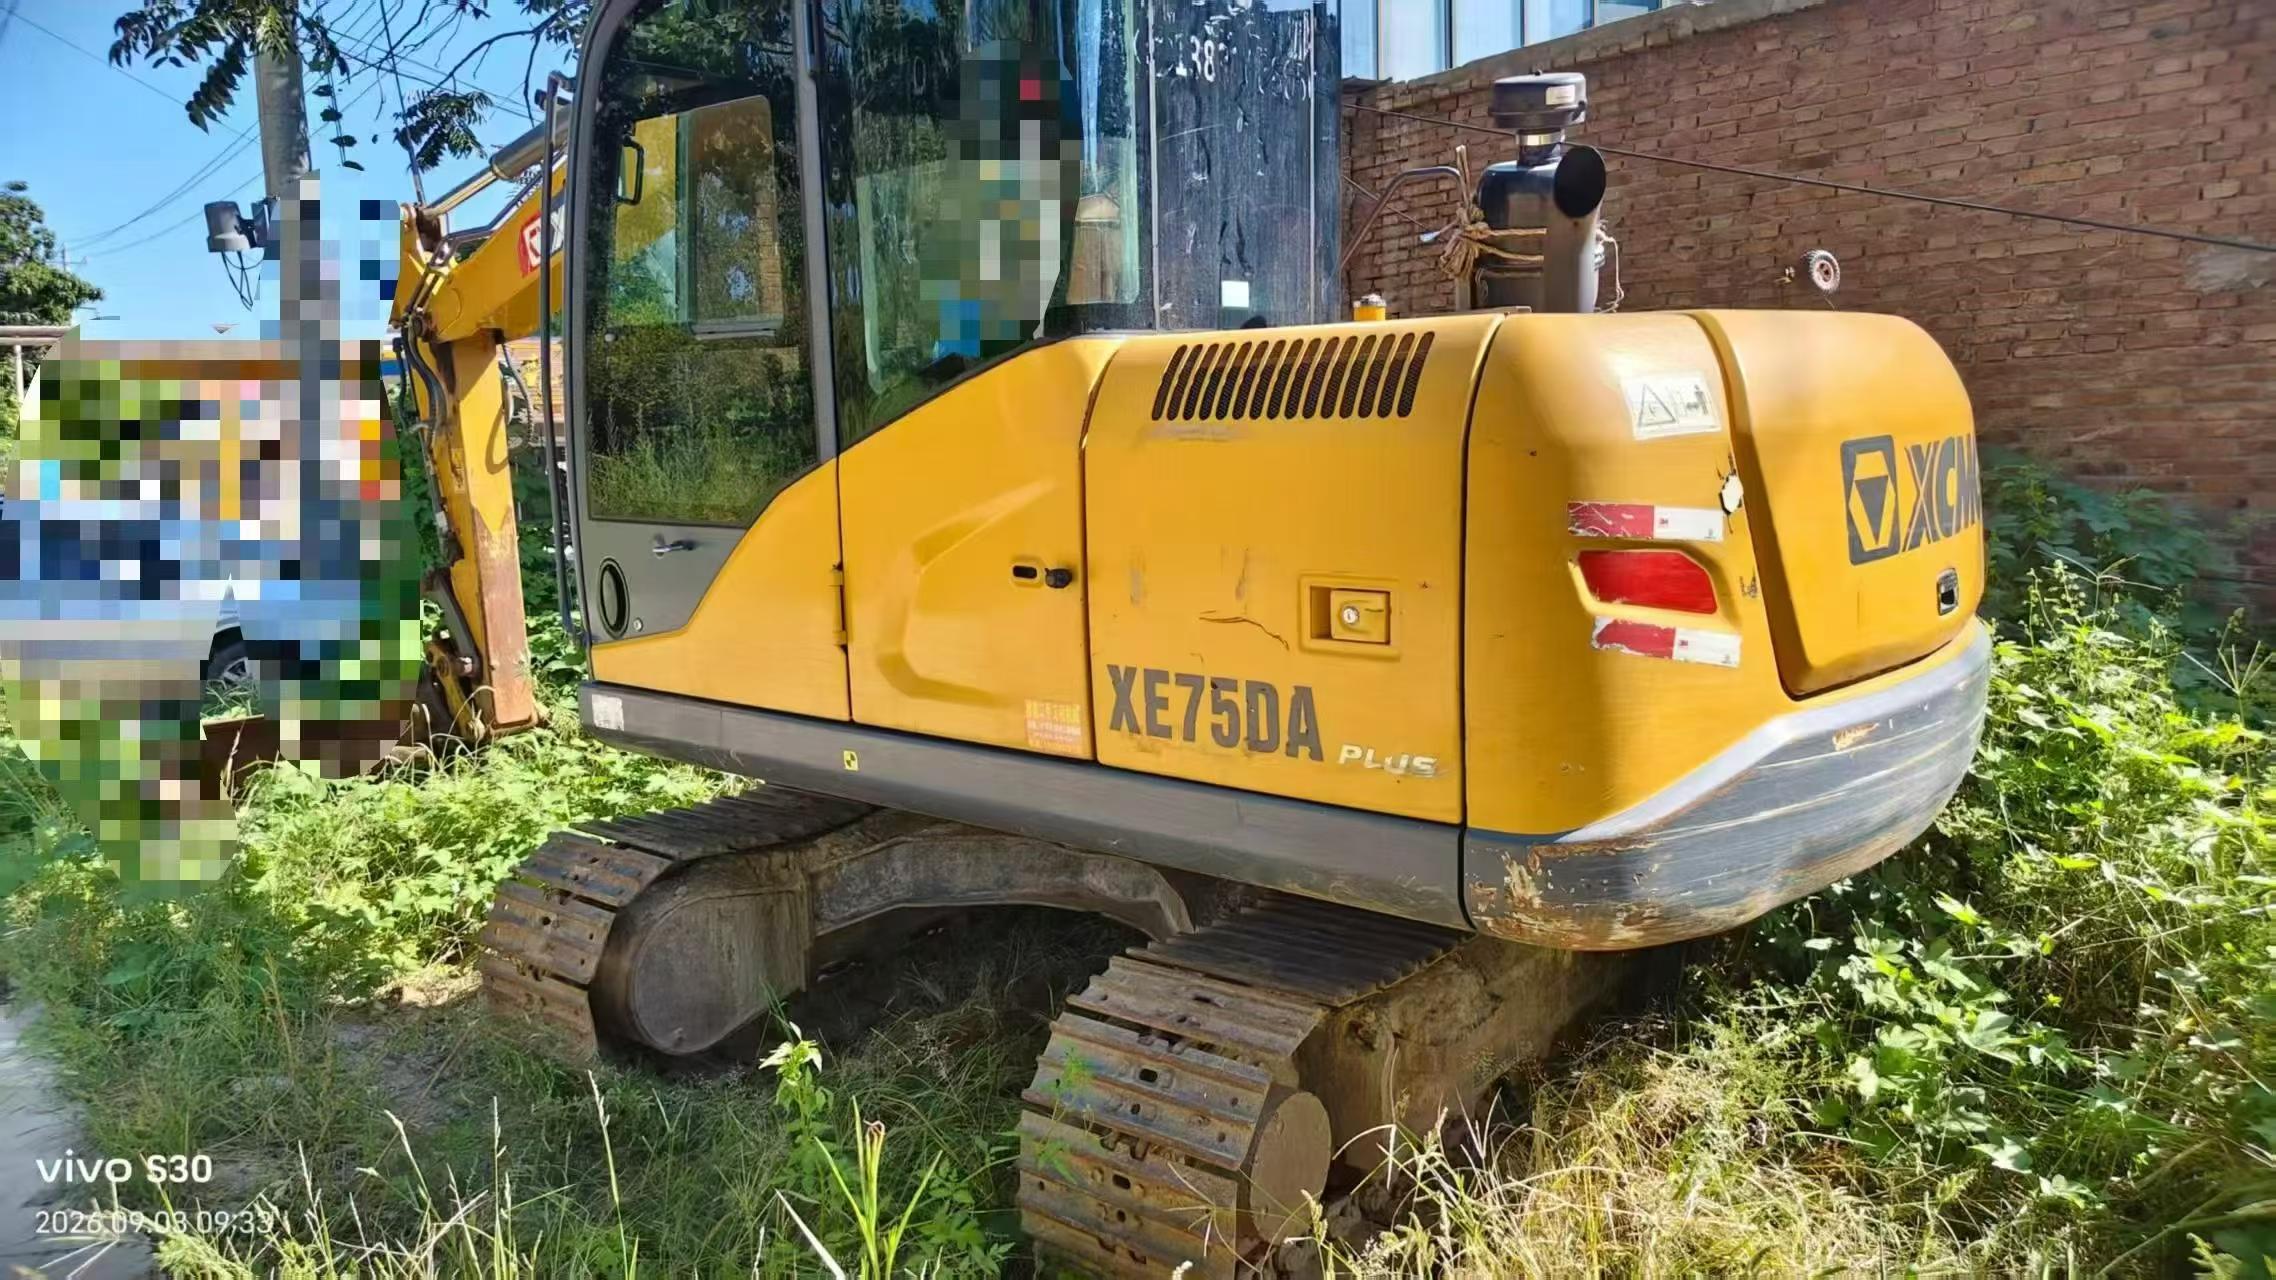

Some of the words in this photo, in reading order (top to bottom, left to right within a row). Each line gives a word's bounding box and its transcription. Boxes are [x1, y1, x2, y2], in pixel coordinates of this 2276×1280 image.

[1901, 431, 1981, 553] XCM
[1106, 664, 1324, 762] XE75DA
[1337, 744, 1438, 778] PLUS
